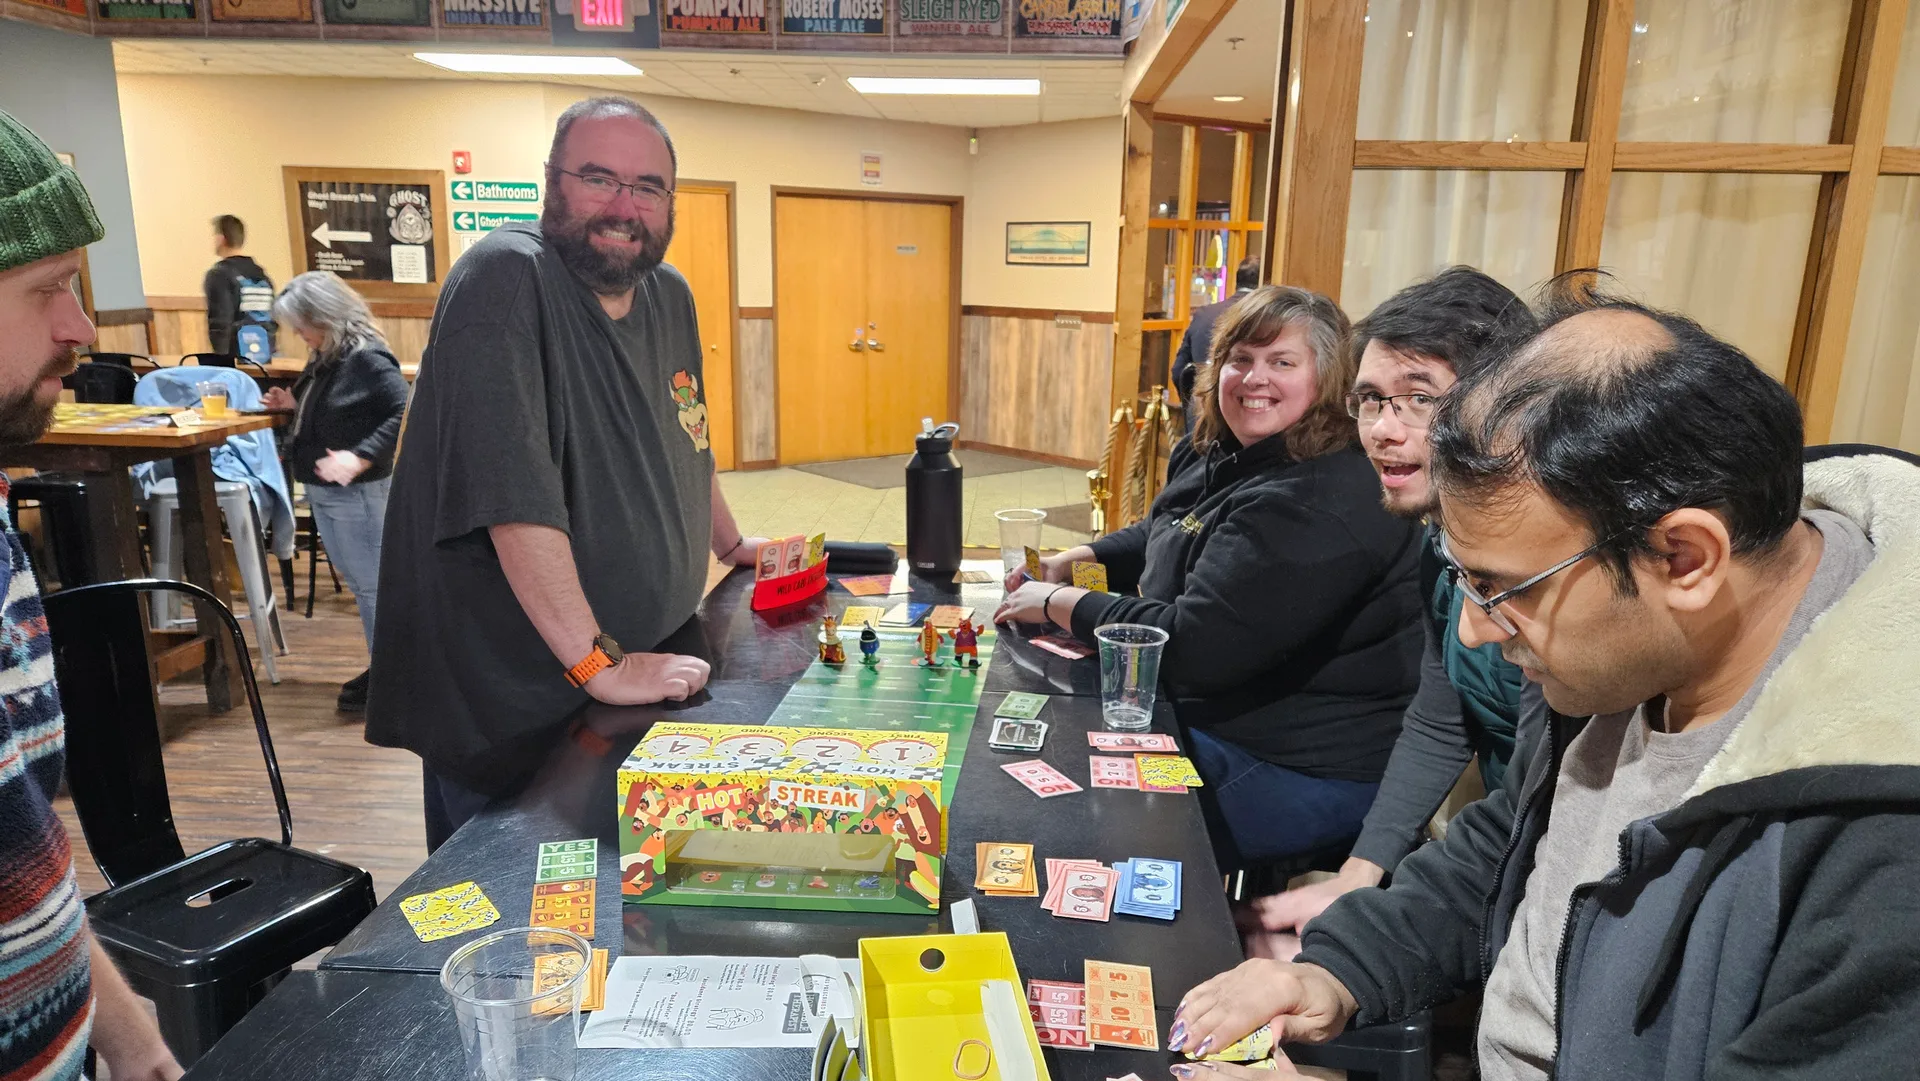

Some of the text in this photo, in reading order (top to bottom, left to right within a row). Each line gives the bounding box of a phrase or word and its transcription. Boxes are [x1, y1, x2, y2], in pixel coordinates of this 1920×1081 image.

[581, 0, 623, 26] EXIT
[667, 0, 764, 17] PUMPKIN
[784, 0, 883, 20] ROBERT MOSES
[901, 0, 1000, 21] SLEIGH RYED
[446, 11, 541, 26] INDIA PALE ALE
[672, 16, 760, 31] PUMPKIN ALE
[804, 19, 865, 33] PALE ALE
[911, 24, 991, 33] WINTER ALE
[389, 190, 428, 207] GHOST
[477, 184, 537, 199] Bathrooms
[480, 216, 502, 227] Ghost
[668, 740, 691, 755] 4
[738, 743, 760, 755] 3
[816, 745, 839, 758] 2
[895, 747, 910, 760] 1
[650, 761, 896, 775] HOT STREAK
[1040, 783, 1073, 794] NO
[1097, 778, 1132, 787] NO
[696, 785, 859, 812] HOT STREAK
[547, 841, 592, 853] YES
[1035, 1029, 1084, 1046] NO
